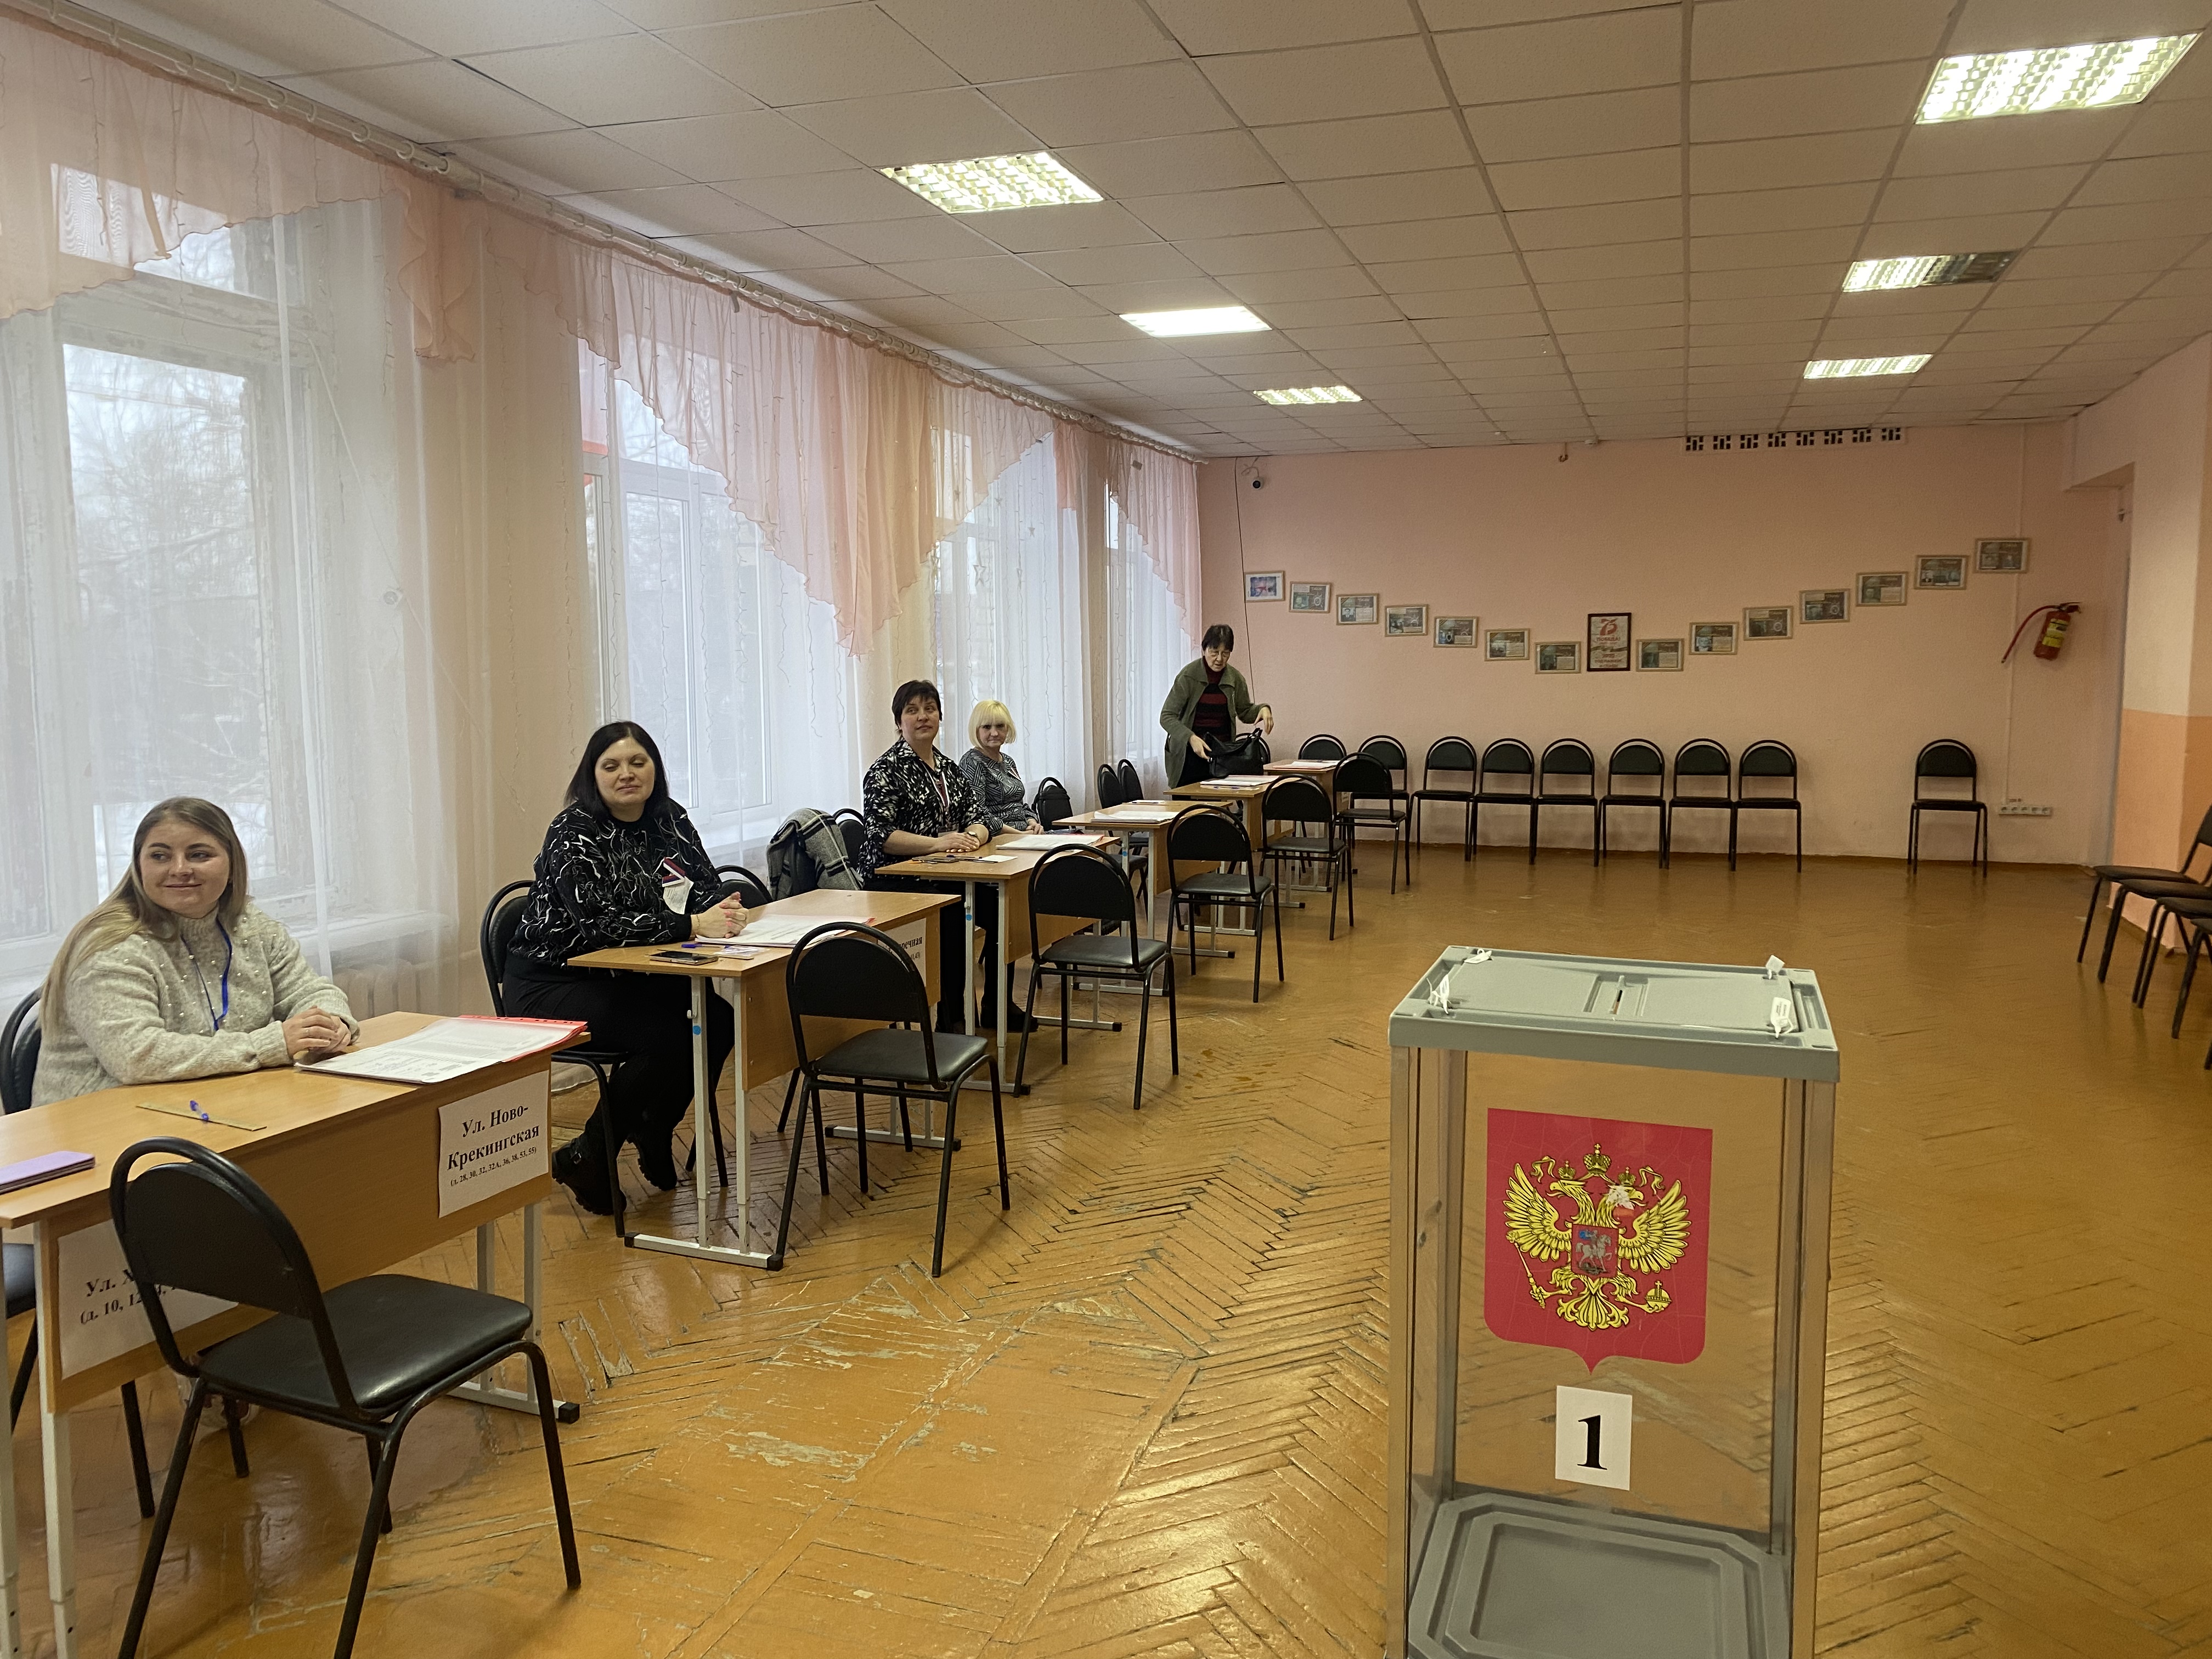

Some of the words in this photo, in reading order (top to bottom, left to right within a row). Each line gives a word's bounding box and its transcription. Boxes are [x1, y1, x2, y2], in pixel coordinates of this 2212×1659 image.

[462, 1119, 485, 1137] Ул.
[490, 1105, 528, 1127] Ново-
[447, 1125, 539, 1170] Крекингская
[469, 1170, 478, 1179] 30,
[86, 1278, 116, 1297] Ул.
[104, 1299, 124, 1315] 10,
[1577, 1415, 1607, 1470] 1
